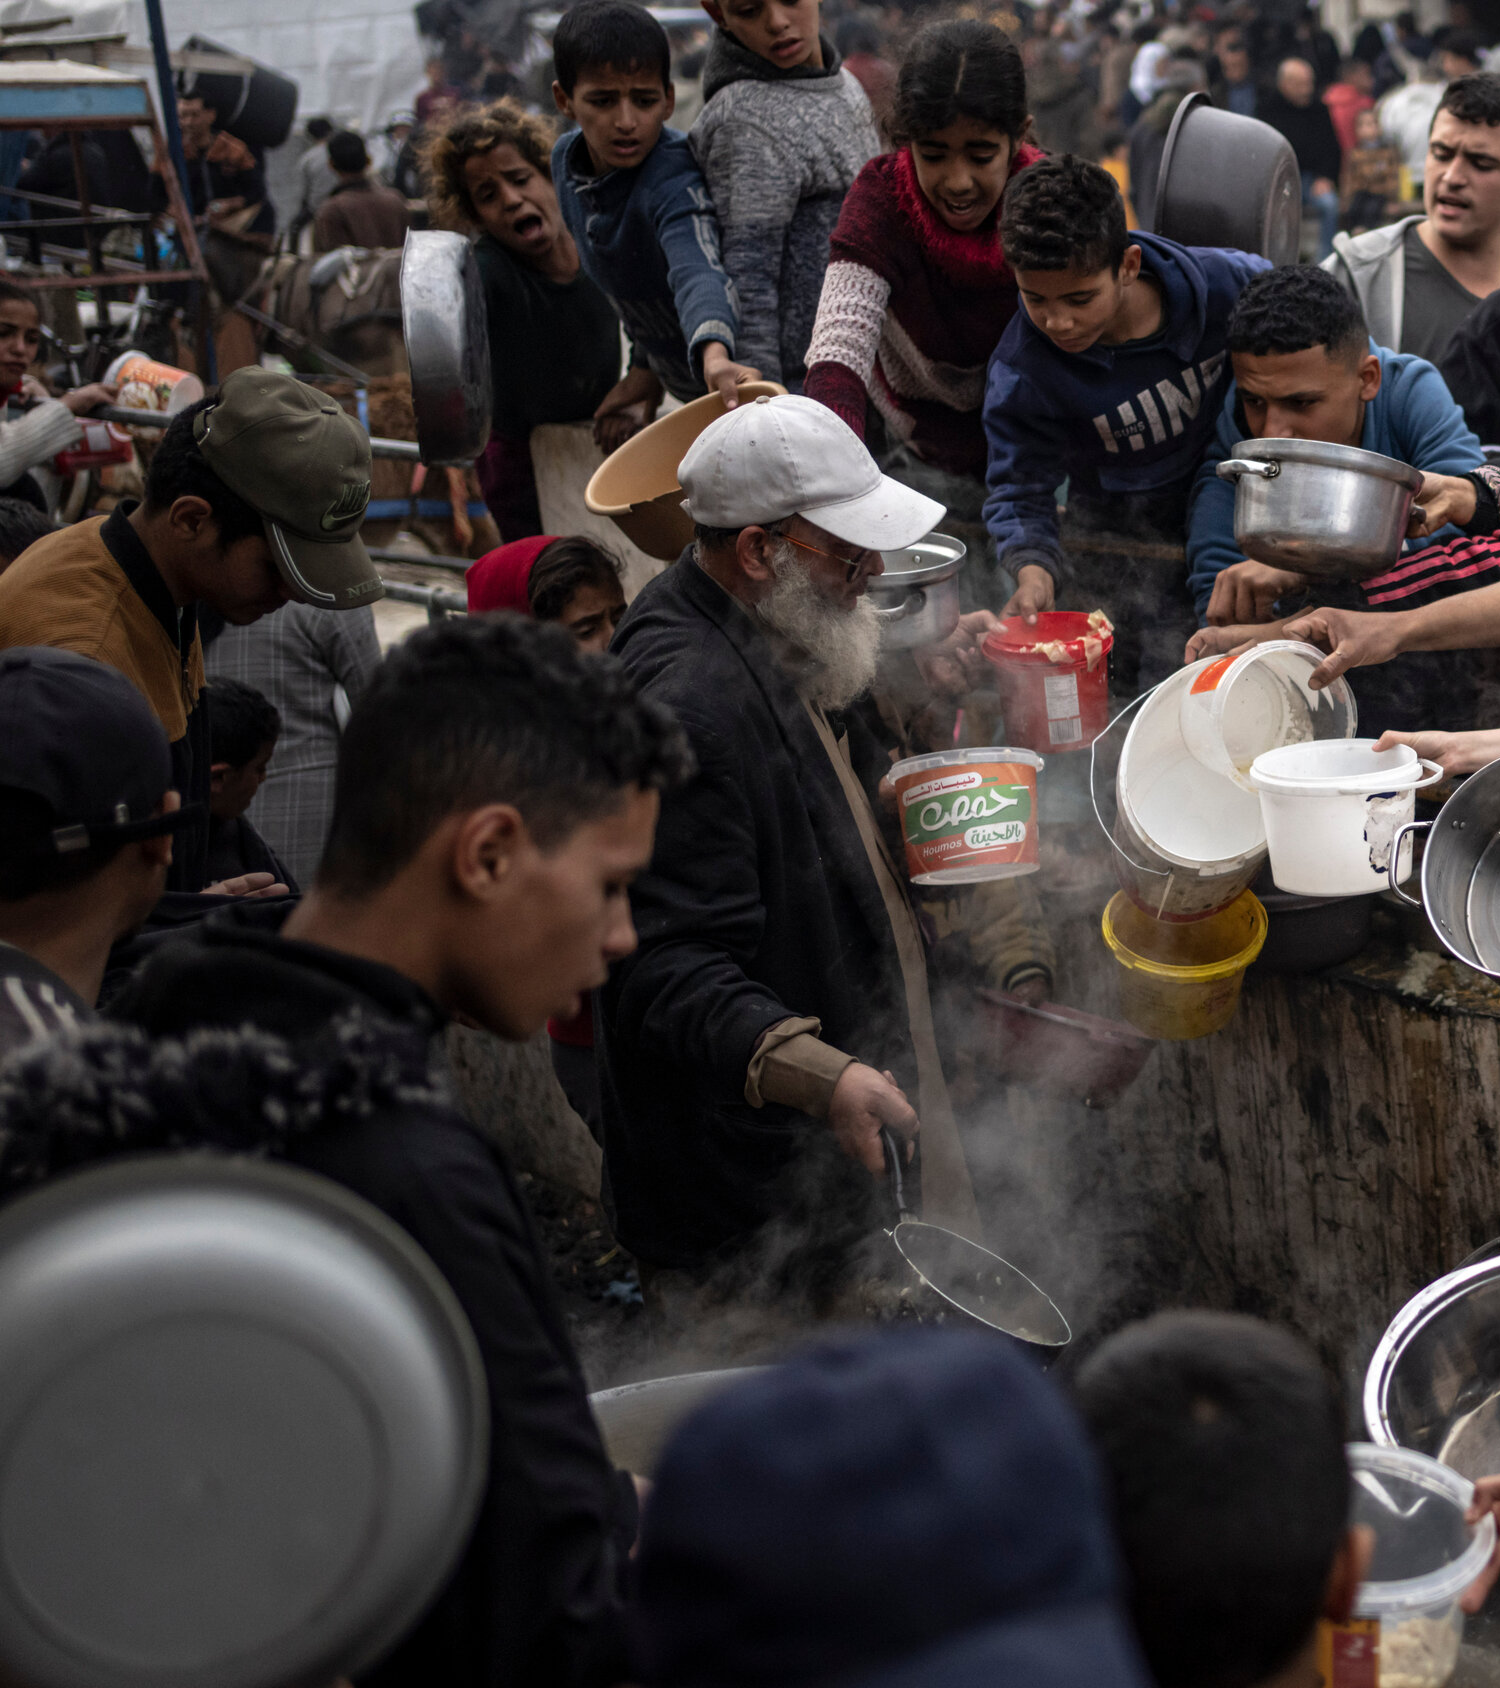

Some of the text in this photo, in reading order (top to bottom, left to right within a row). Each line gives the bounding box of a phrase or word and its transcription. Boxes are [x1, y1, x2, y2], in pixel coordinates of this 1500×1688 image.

[919, 787, 1018, 832] حمص
[970, 823, 1021, 846] بالطحينة
[923, 839, 962, 857] Houmos
